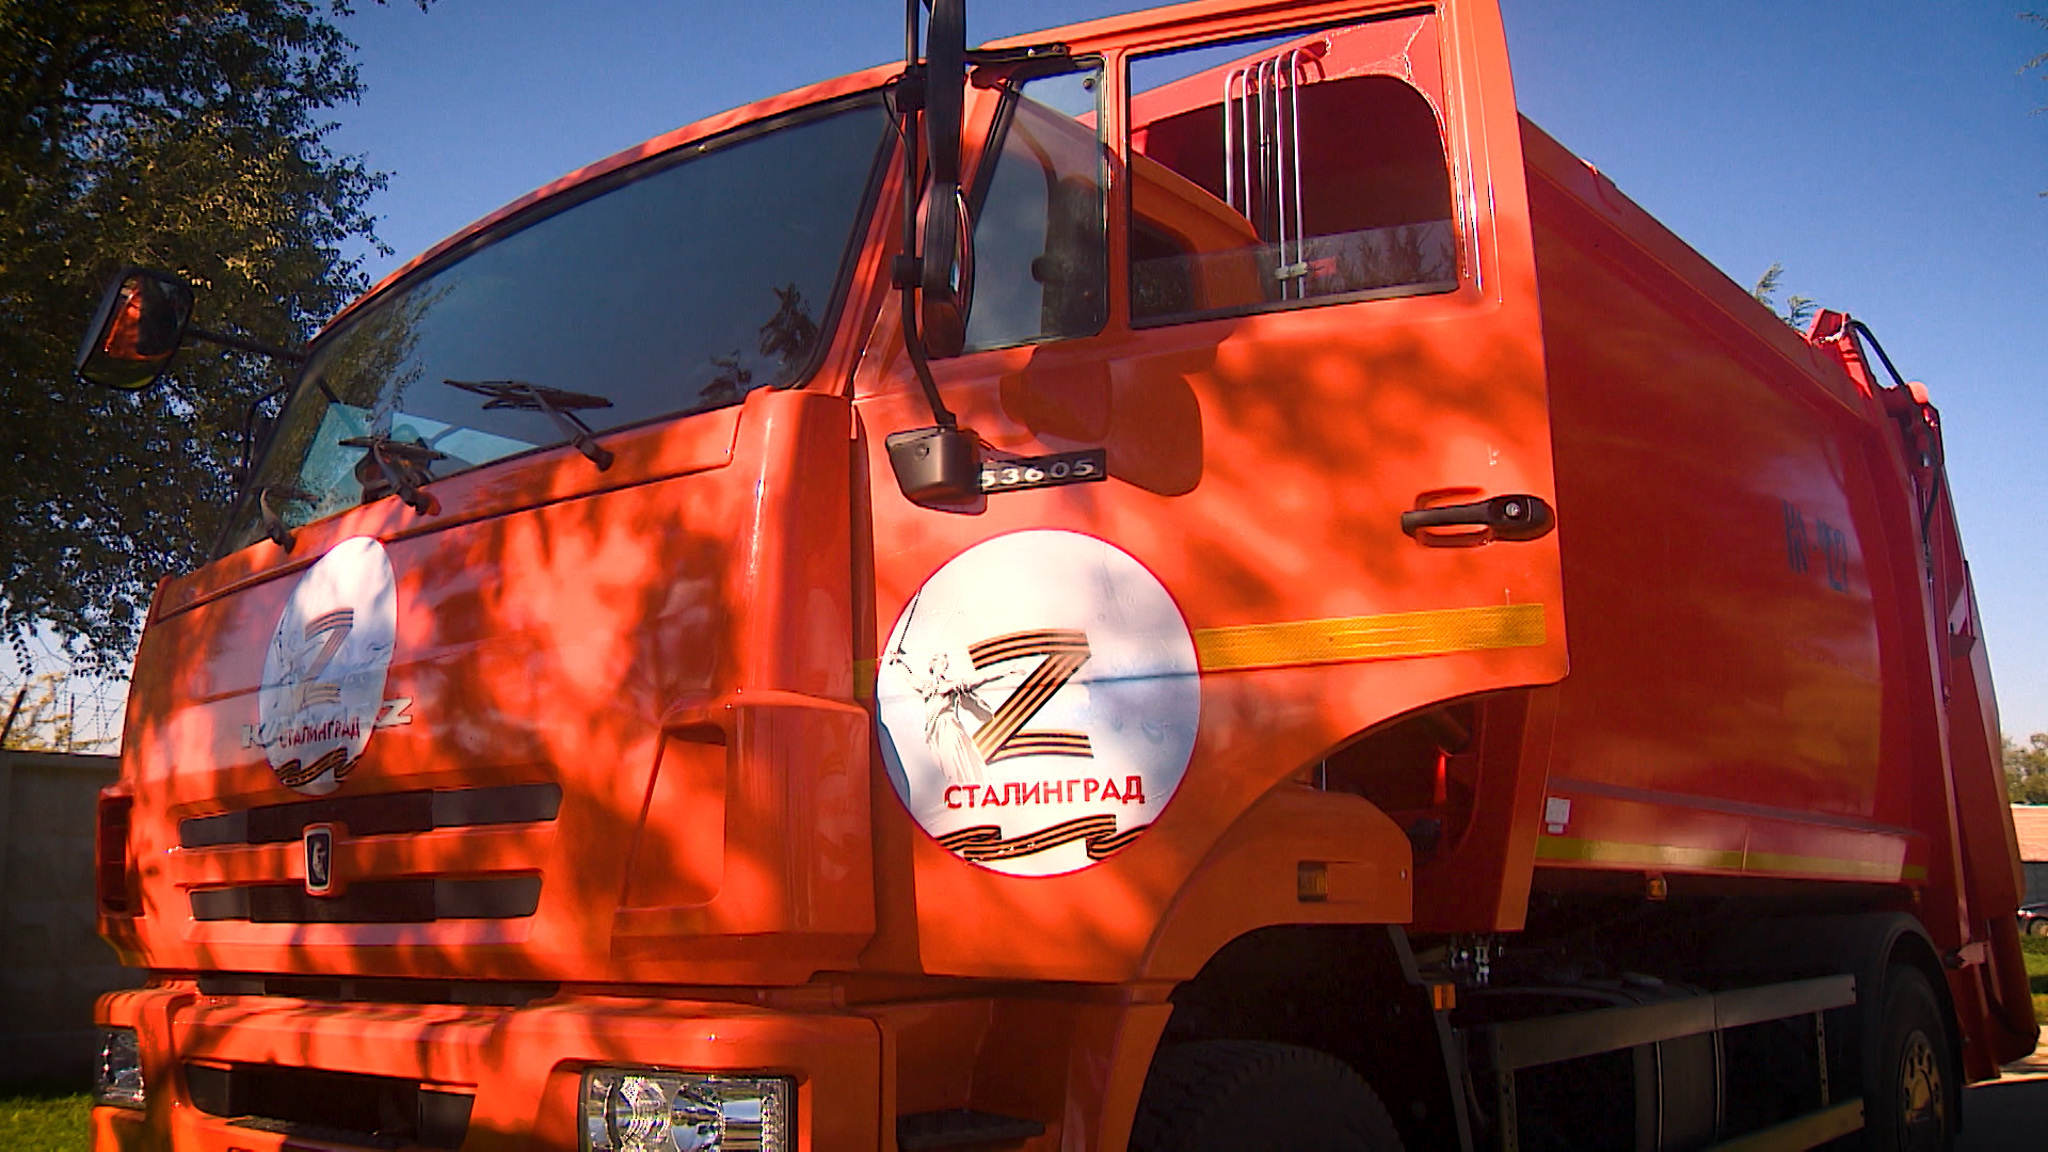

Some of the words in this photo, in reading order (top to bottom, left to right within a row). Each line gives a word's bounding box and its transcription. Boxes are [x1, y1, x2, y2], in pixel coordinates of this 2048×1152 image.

[982, 458, 1095, 488] 53605
[967, 628, 1094, 766] Z
[279, 716, 361, 749] СТАЛИНГРАД
[944, 775, 1146, 809] СТАЛИНГРАД
